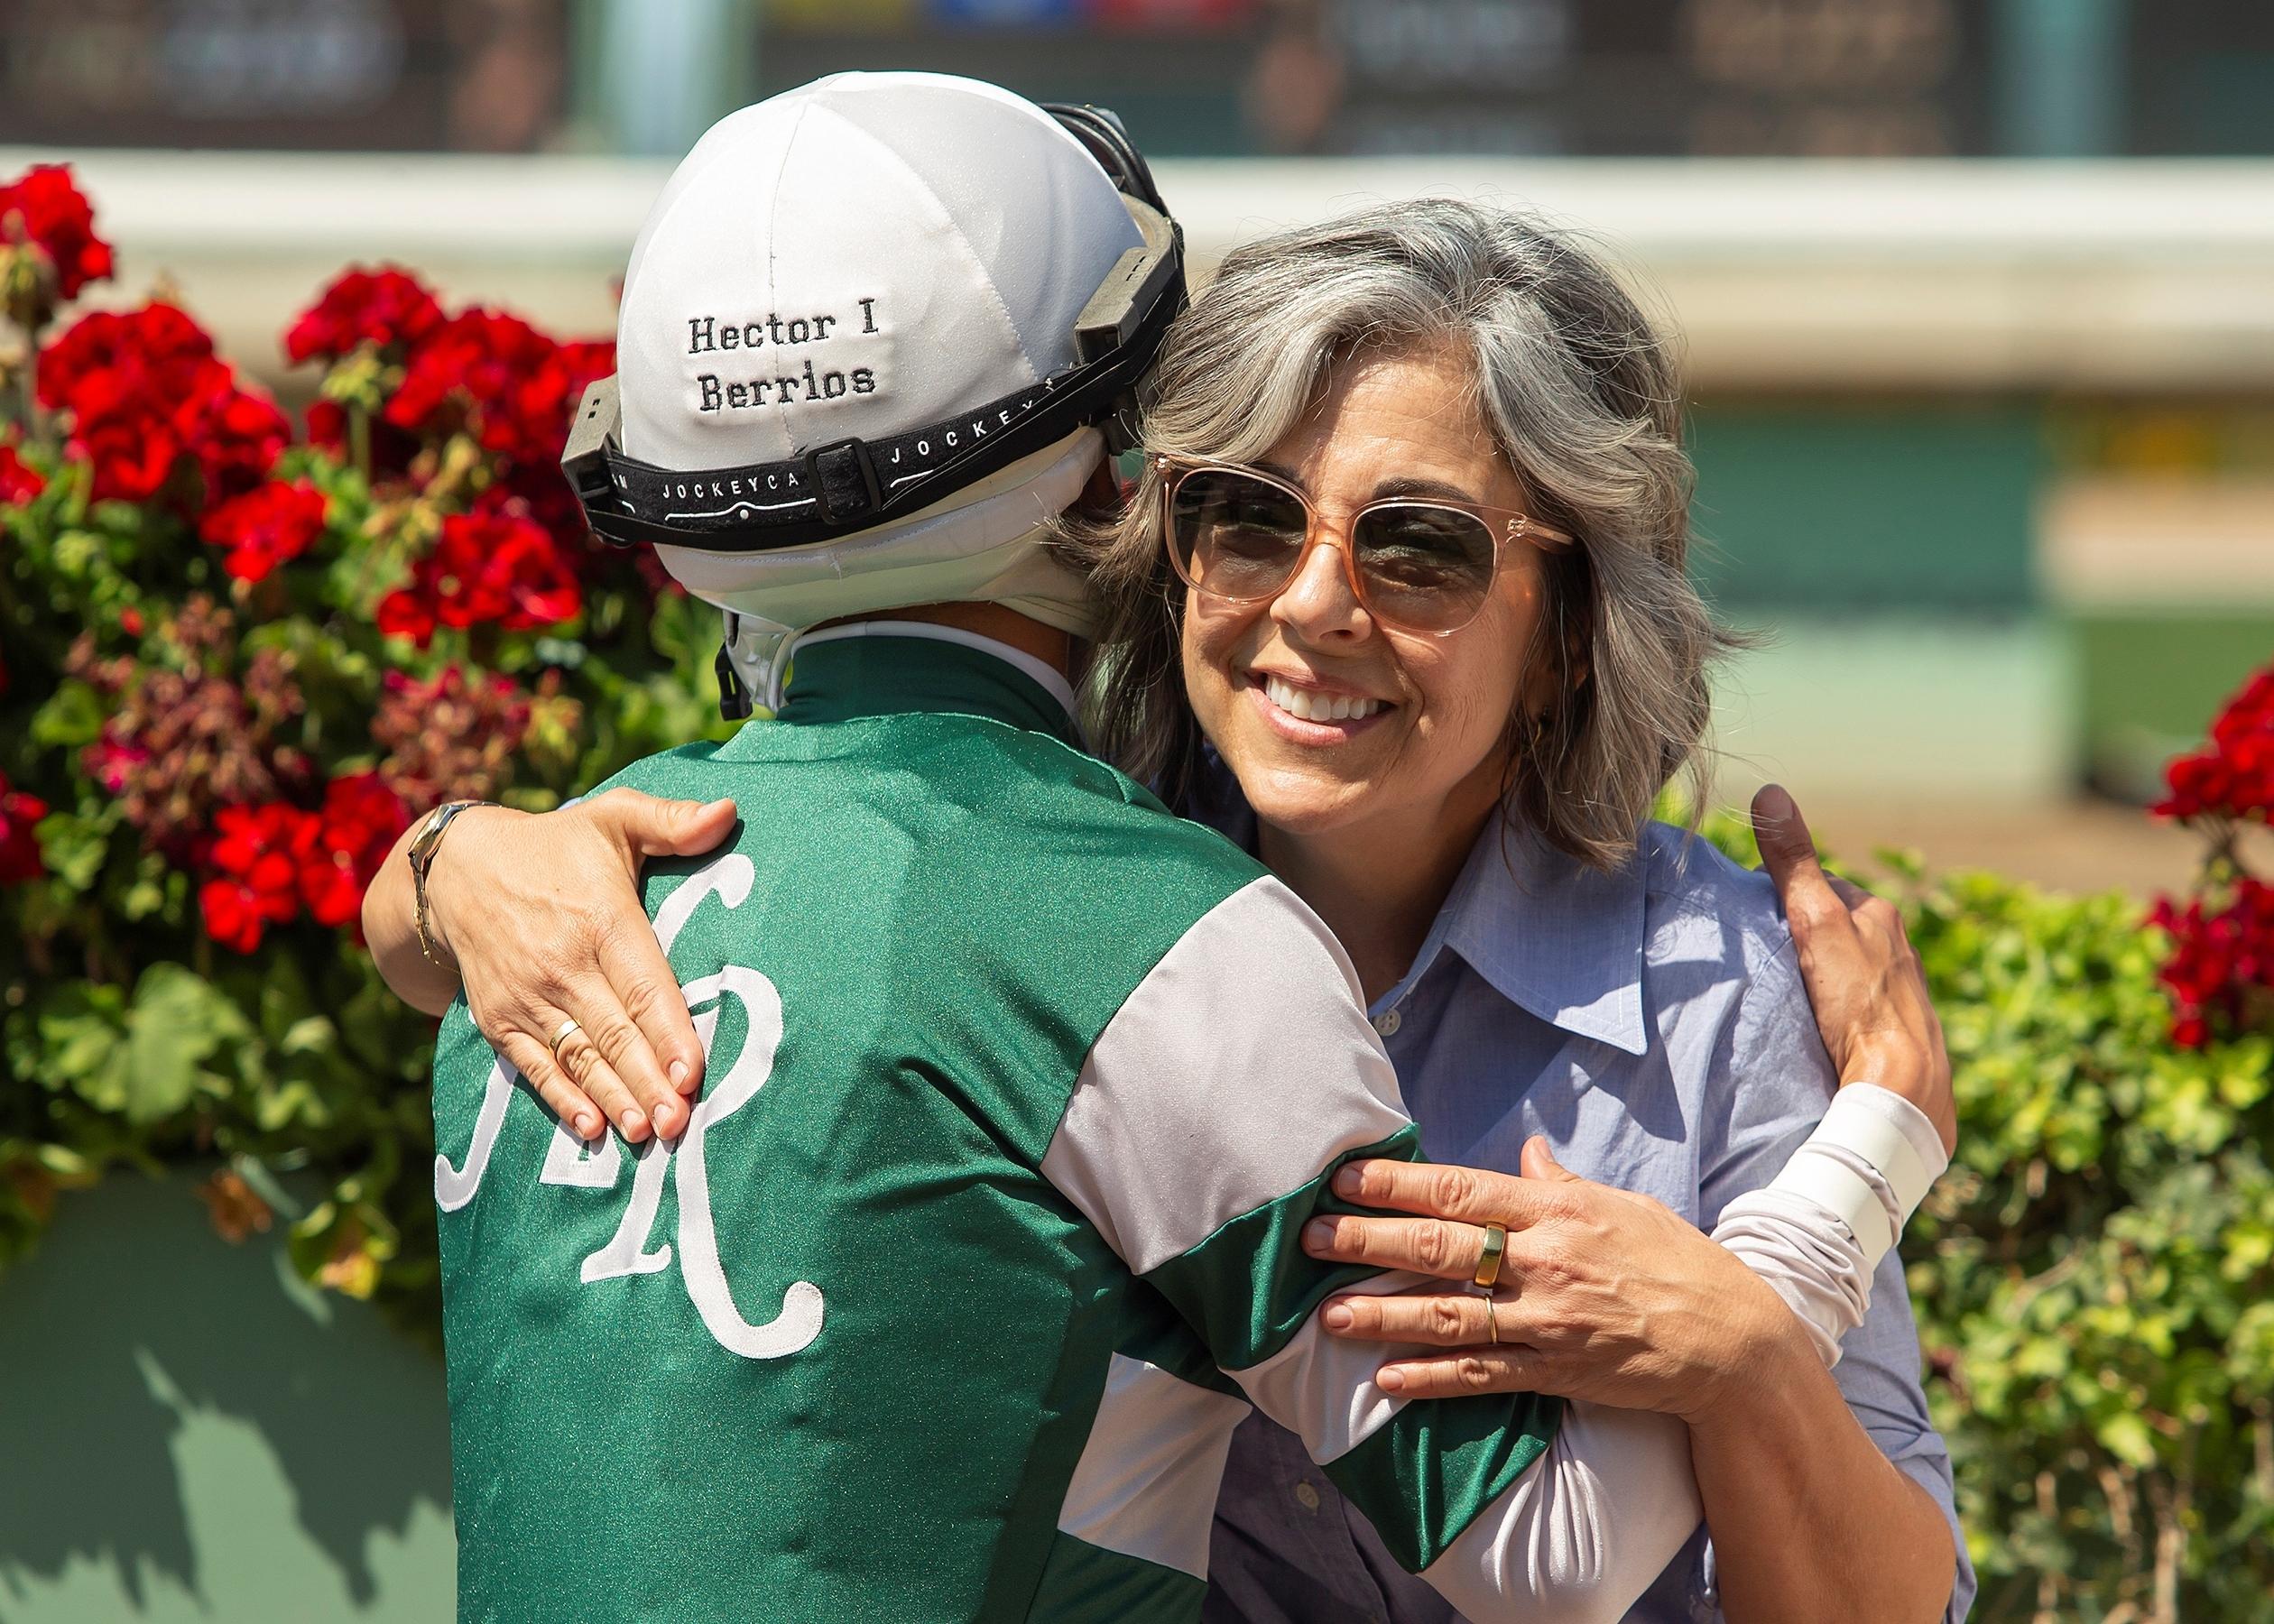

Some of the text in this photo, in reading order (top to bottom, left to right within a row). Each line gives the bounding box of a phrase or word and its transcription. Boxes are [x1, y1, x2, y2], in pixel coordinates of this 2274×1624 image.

[689, 298, 879, 354] Hector I
[697, 359, 876, 411] Berrios
[891, 386, 1054, 464] JOCKEY
